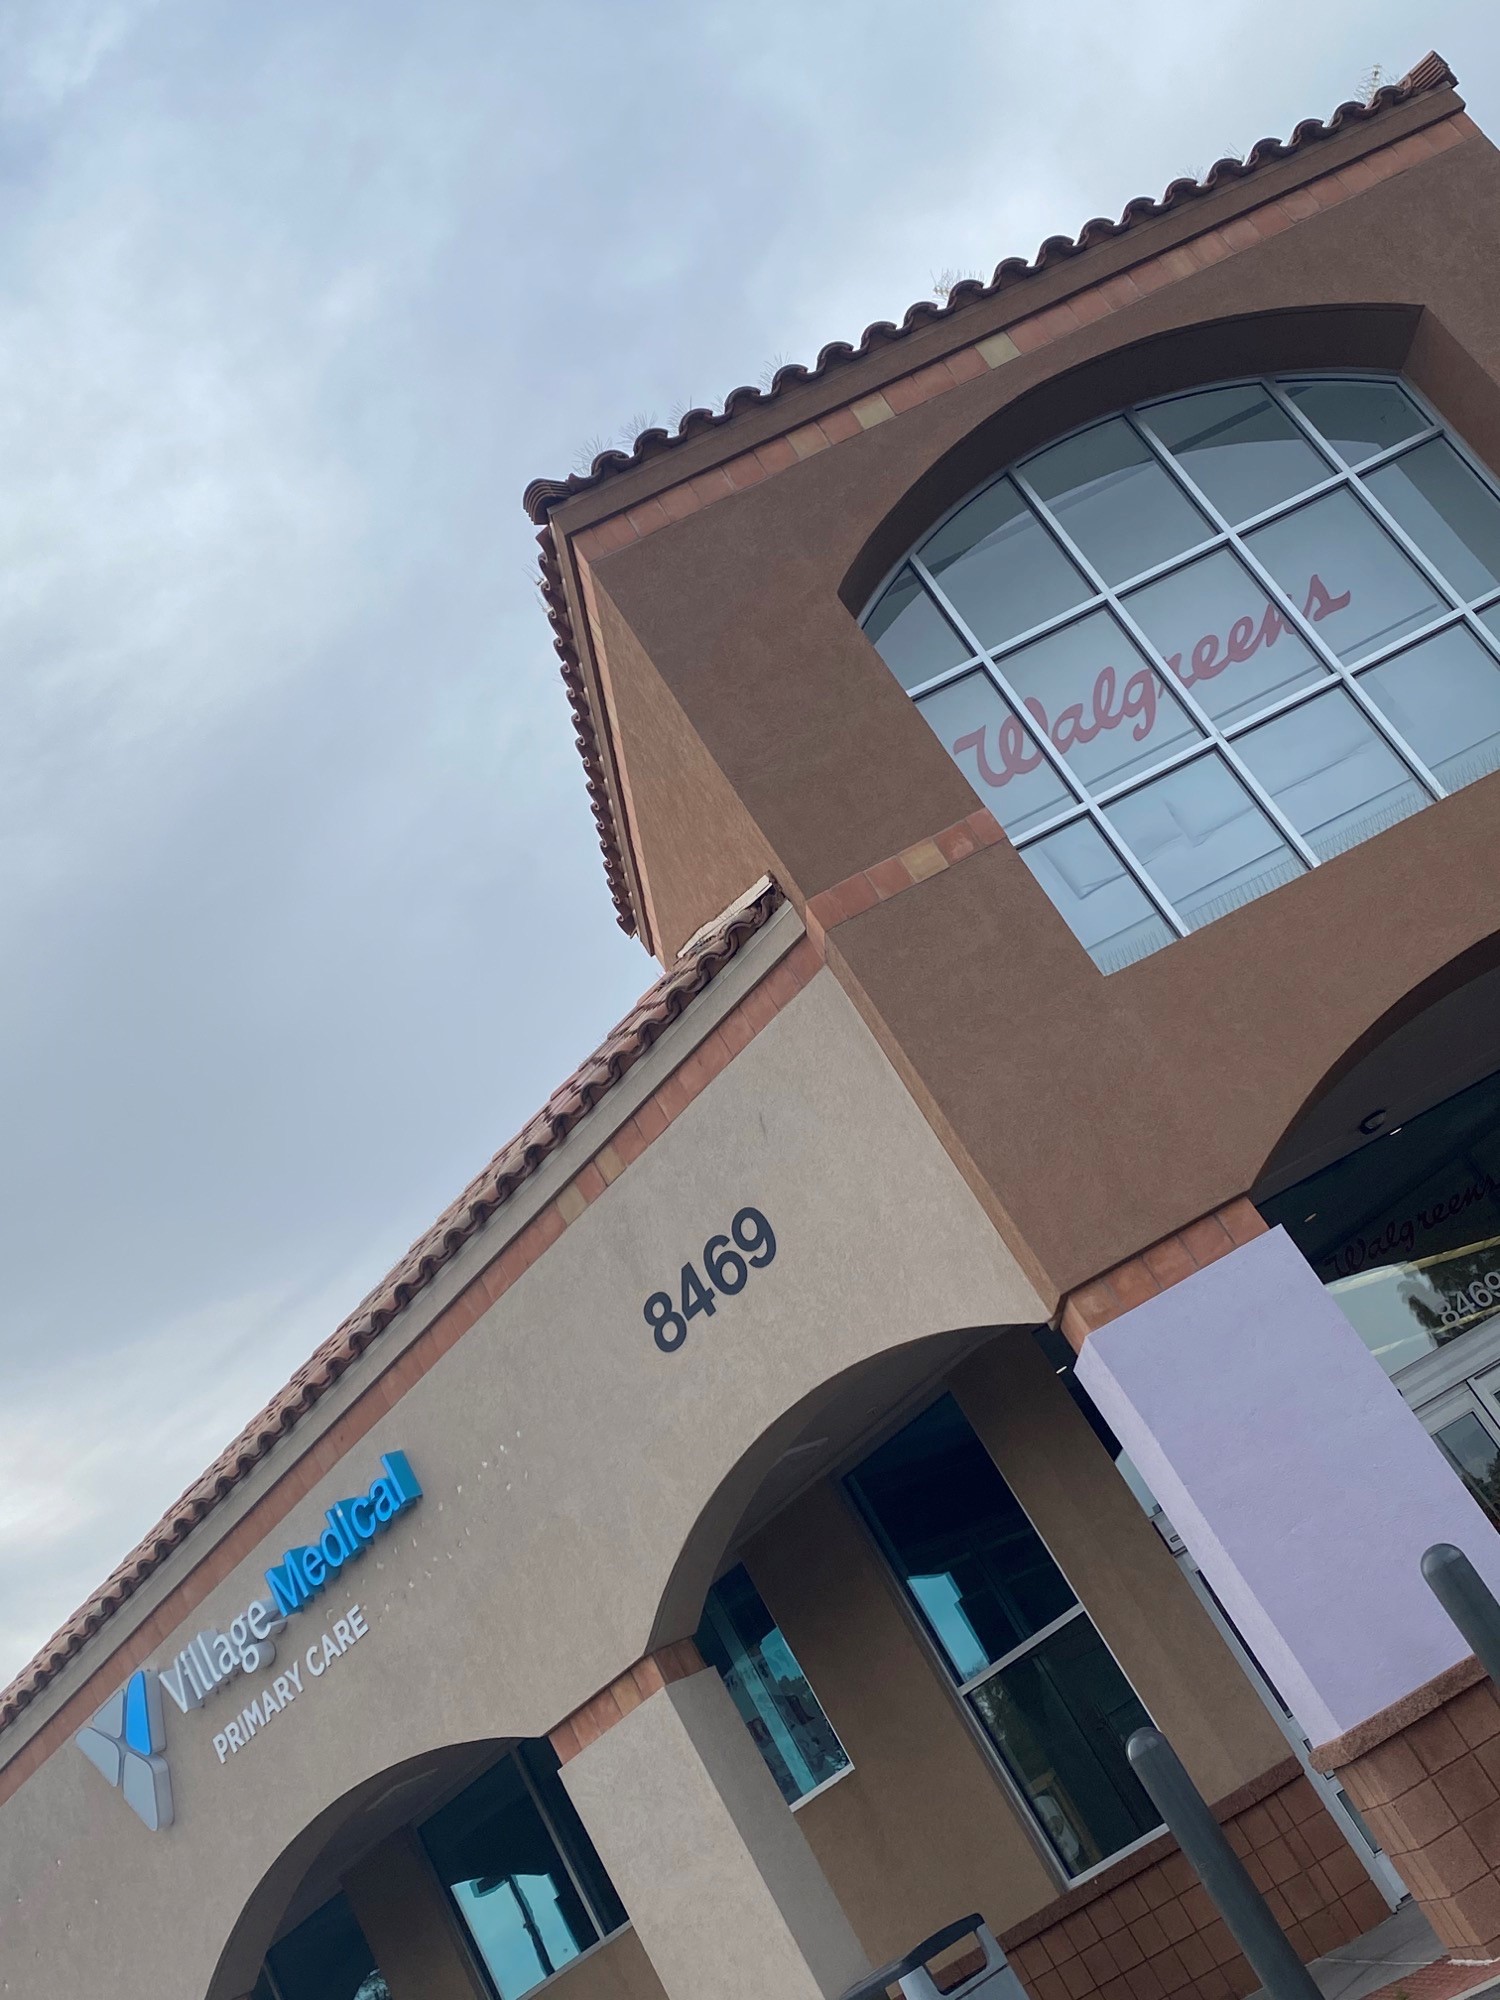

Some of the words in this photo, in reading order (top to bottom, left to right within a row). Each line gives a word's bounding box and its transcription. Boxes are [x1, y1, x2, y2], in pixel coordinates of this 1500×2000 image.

[643, 1206, 777, 1353] 8469
[1439, 1271, 1500, 1327] 8469
[158, 1600, 287, 1714] Village
[264, 1450, 423, 1617] Medical
[212, 1661, 304, 1764] PRIMARY
[305, 1604, 369, 1677] CARE
